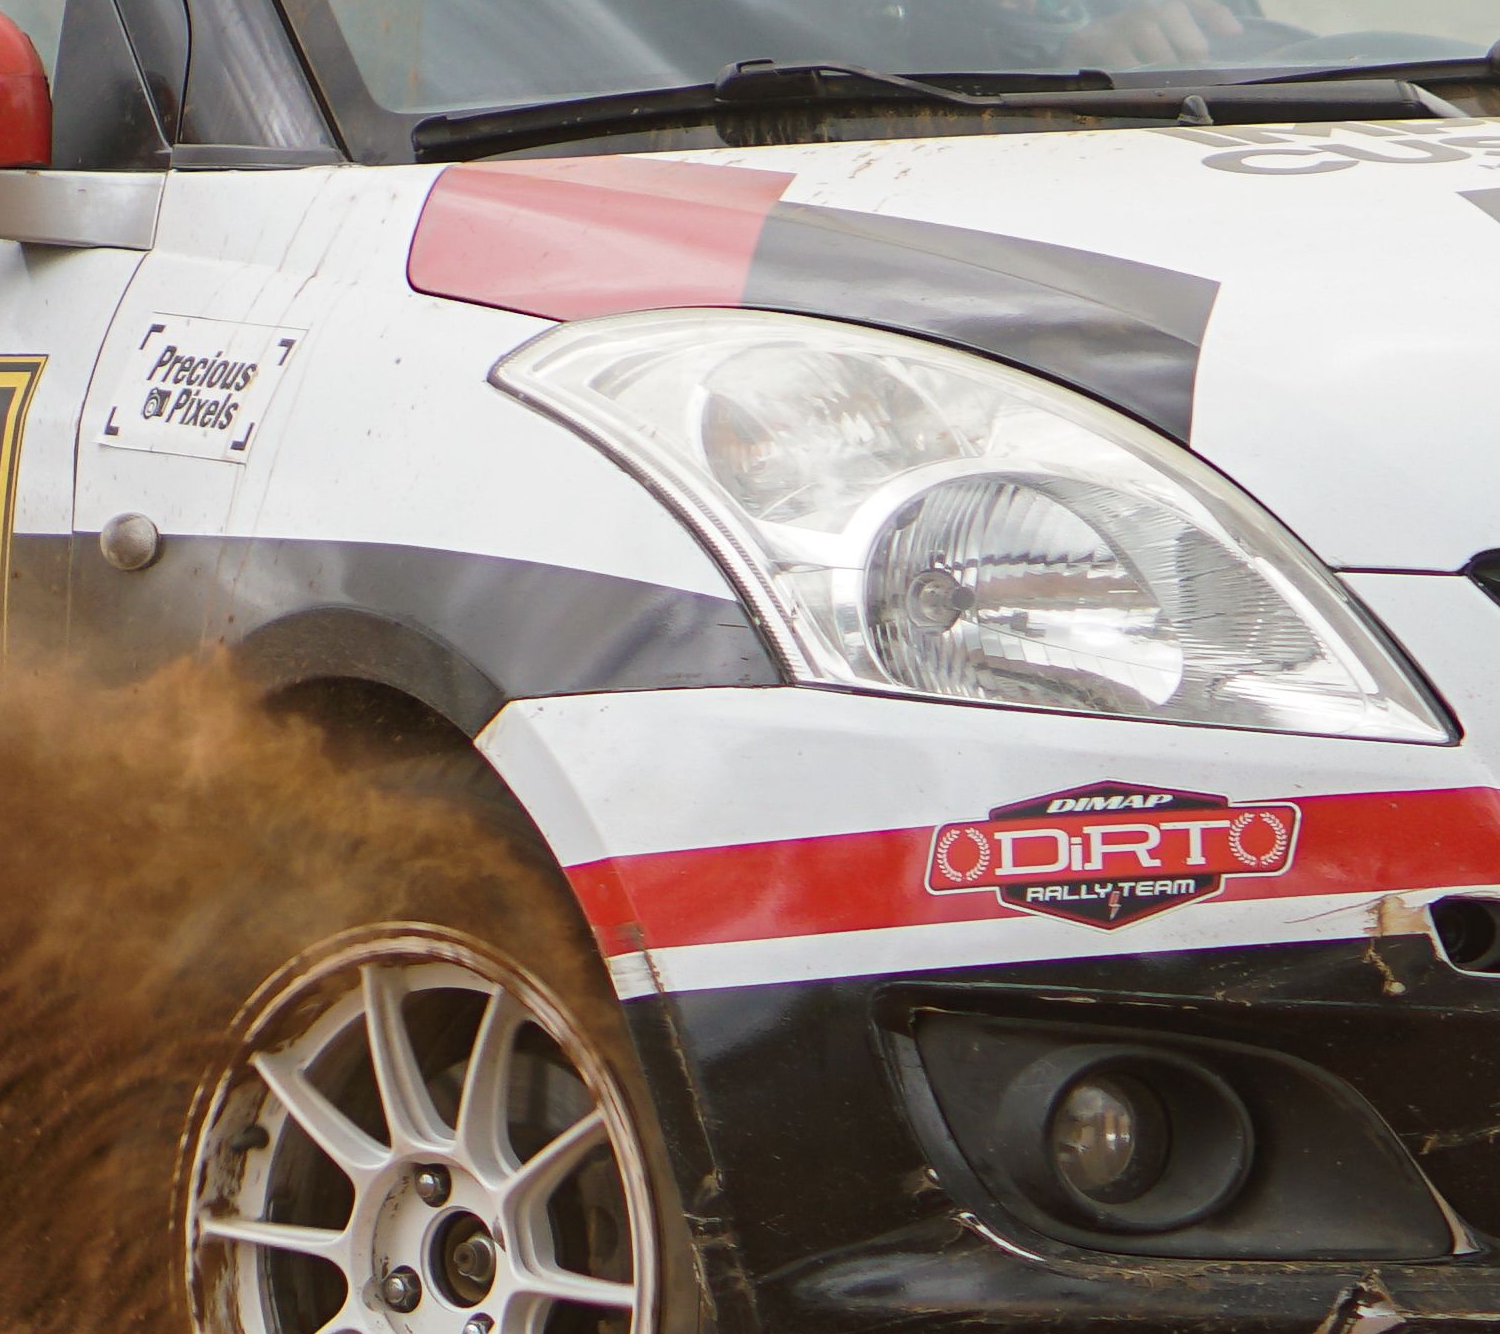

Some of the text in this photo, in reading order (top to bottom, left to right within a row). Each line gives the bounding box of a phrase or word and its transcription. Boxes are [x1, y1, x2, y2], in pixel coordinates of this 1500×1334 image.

[147, 345, 258, 392] Precious
[165, 388, 238, 430] Pixels
[1047, 794, 1174, 814] DIMAP
[1026, 879, 1196, 903] RALLY TEAM
